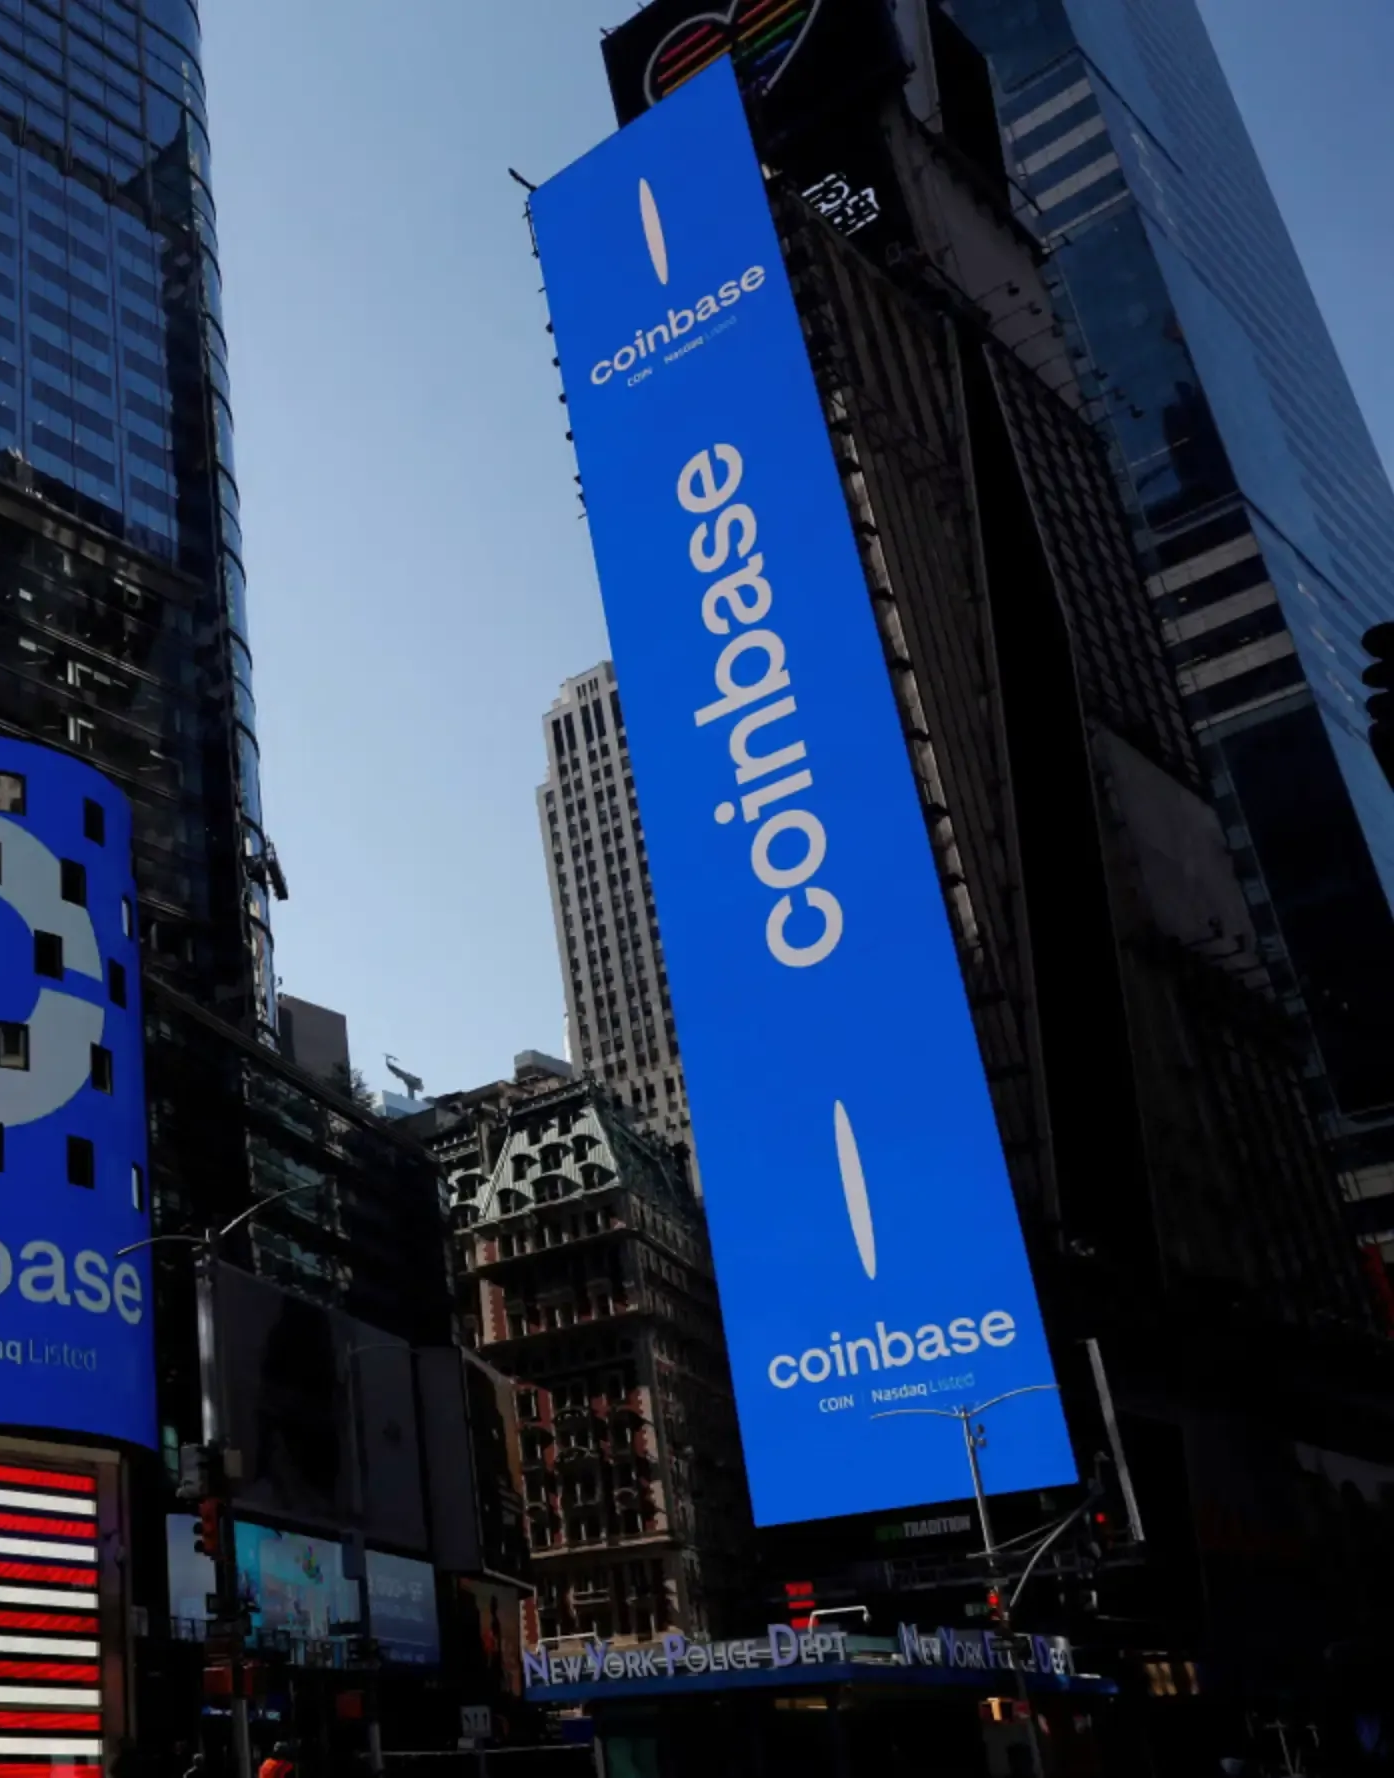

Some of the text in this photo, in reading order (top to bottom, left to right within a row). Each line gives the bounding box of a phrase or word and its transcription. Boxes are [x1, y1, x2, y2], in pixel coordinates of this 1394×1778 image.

[590, 265, 765, 385] coinbase
[677, 443, 843, 968] coinbase
[28, 1340, 97, 1371] Listed
[768, 1310, 1016, 1389] coinbase
[819, 1372, 976, 1413] COIN Nasdaq Listed
